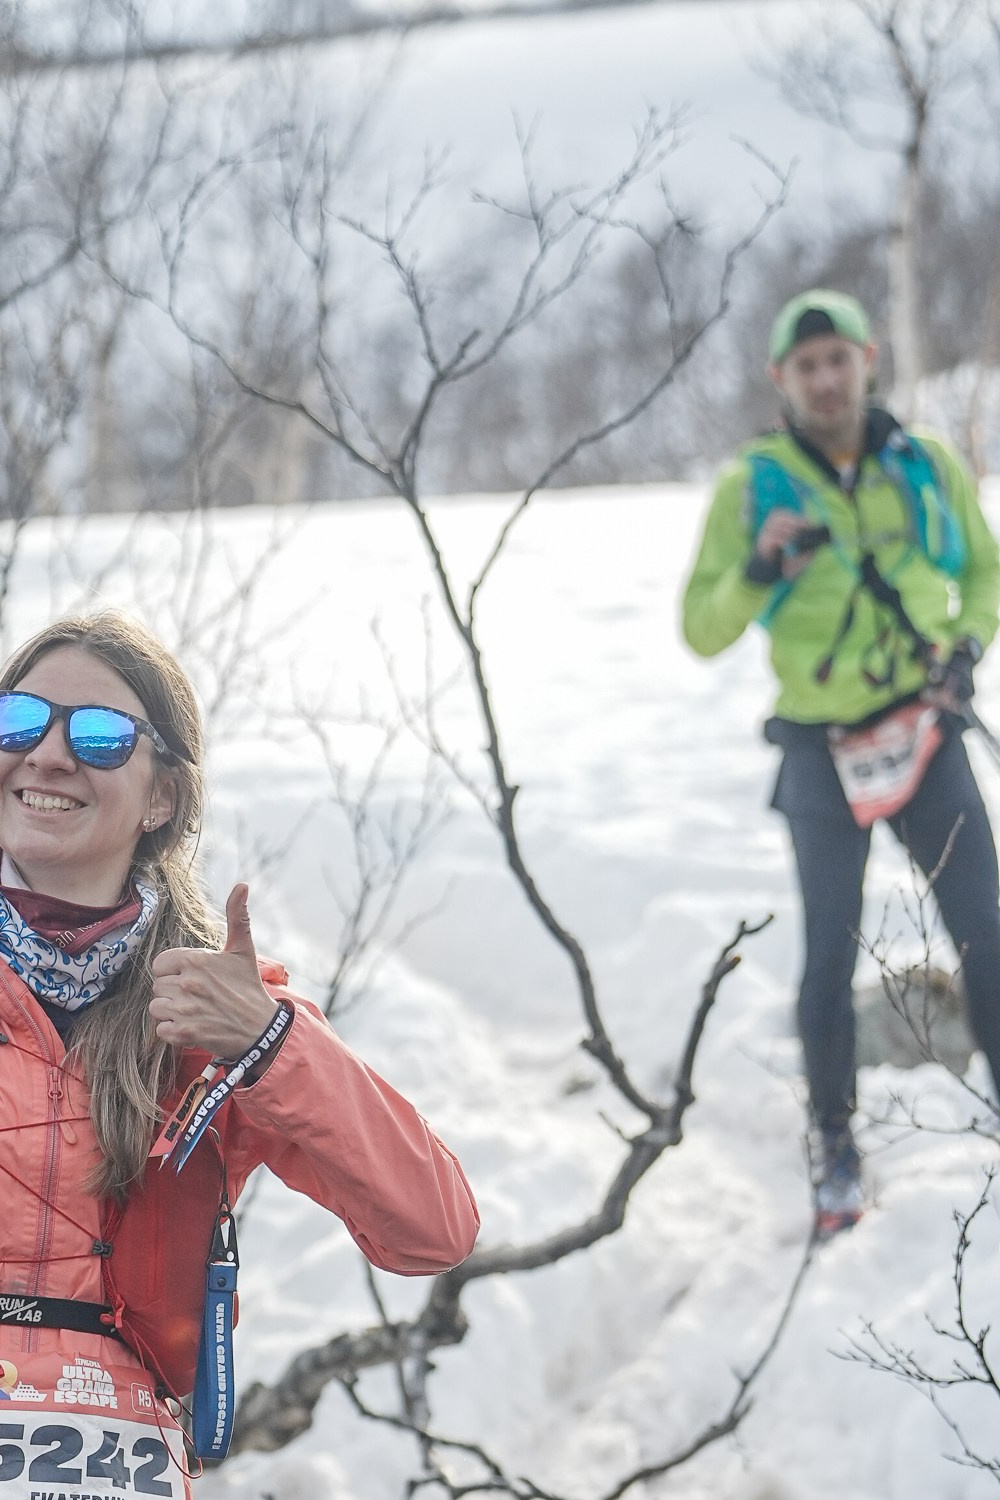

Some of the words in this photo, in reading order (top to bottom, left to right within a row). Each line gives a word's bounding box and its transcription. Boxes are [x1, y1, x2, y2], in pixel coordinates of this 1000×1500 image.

[258, 1010, 290, 1050] ULTRA
[188, 1082, 230, 1136] ESCAPE
[16, 1309, 43, 1323] LAB
[215, 1302, 225, 1344] ULTRA
[56, 1377, 115, 1396] GRAND
[62, 1365, 113, 1384] ULTRA
[216, 1344, 227, 1392] GRAND
[53, 1390, 118, 1410] ESCAPE
[213, 1393, 227, 1445] ESCAPE
